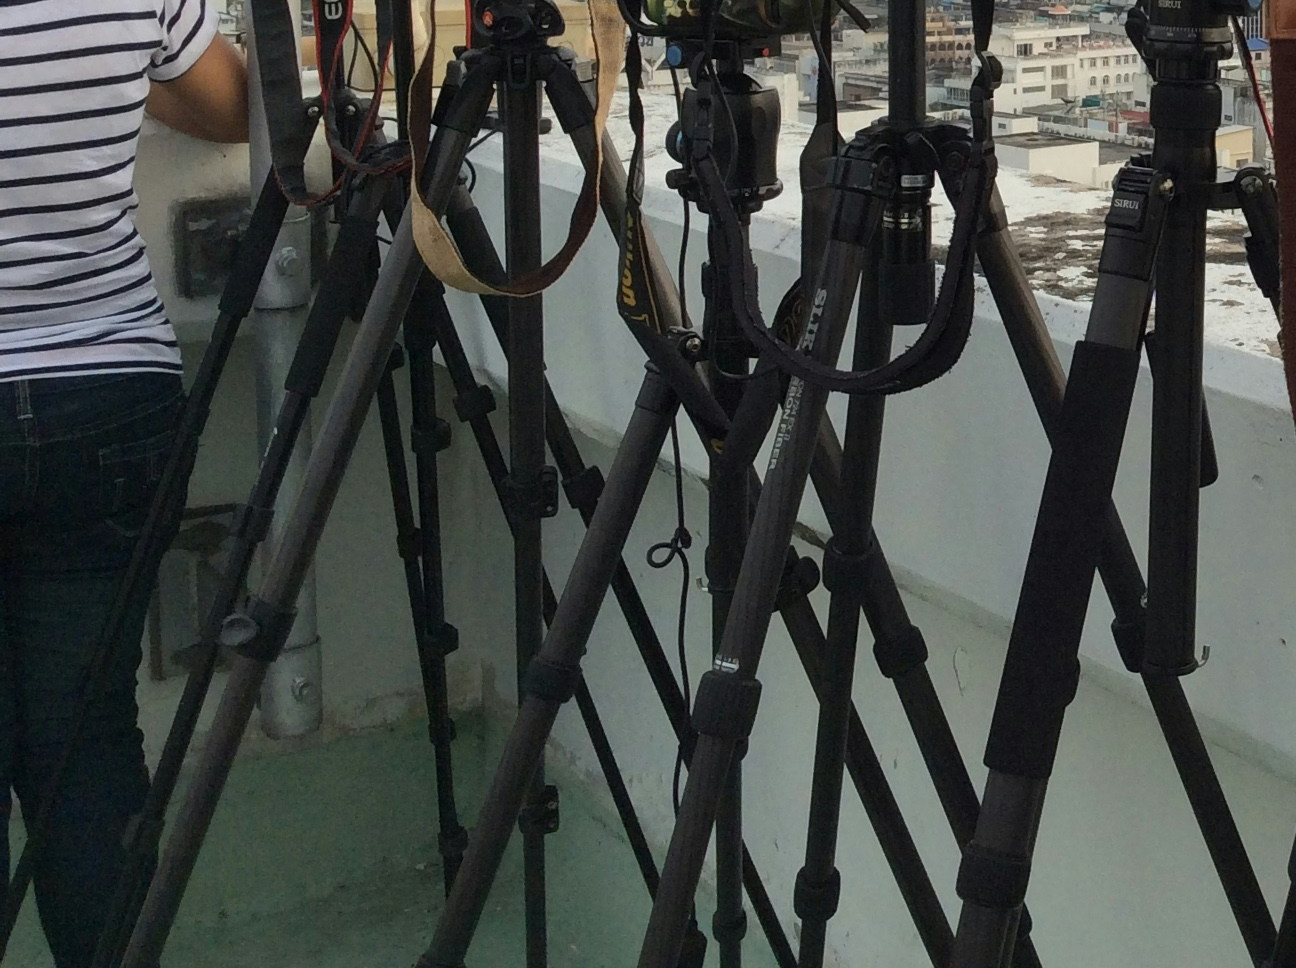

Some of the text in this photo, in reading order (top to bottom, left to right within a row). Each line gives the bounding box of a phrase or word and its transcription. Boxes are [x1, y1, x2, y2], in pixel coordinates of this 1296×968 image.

[1158, 0, 1182, 9] SIRUI
[1114, 198, 1139, 210] SIRUI
[801, 287, 828, 351] SLIK
[768, 423, 787, 470] FIBER
